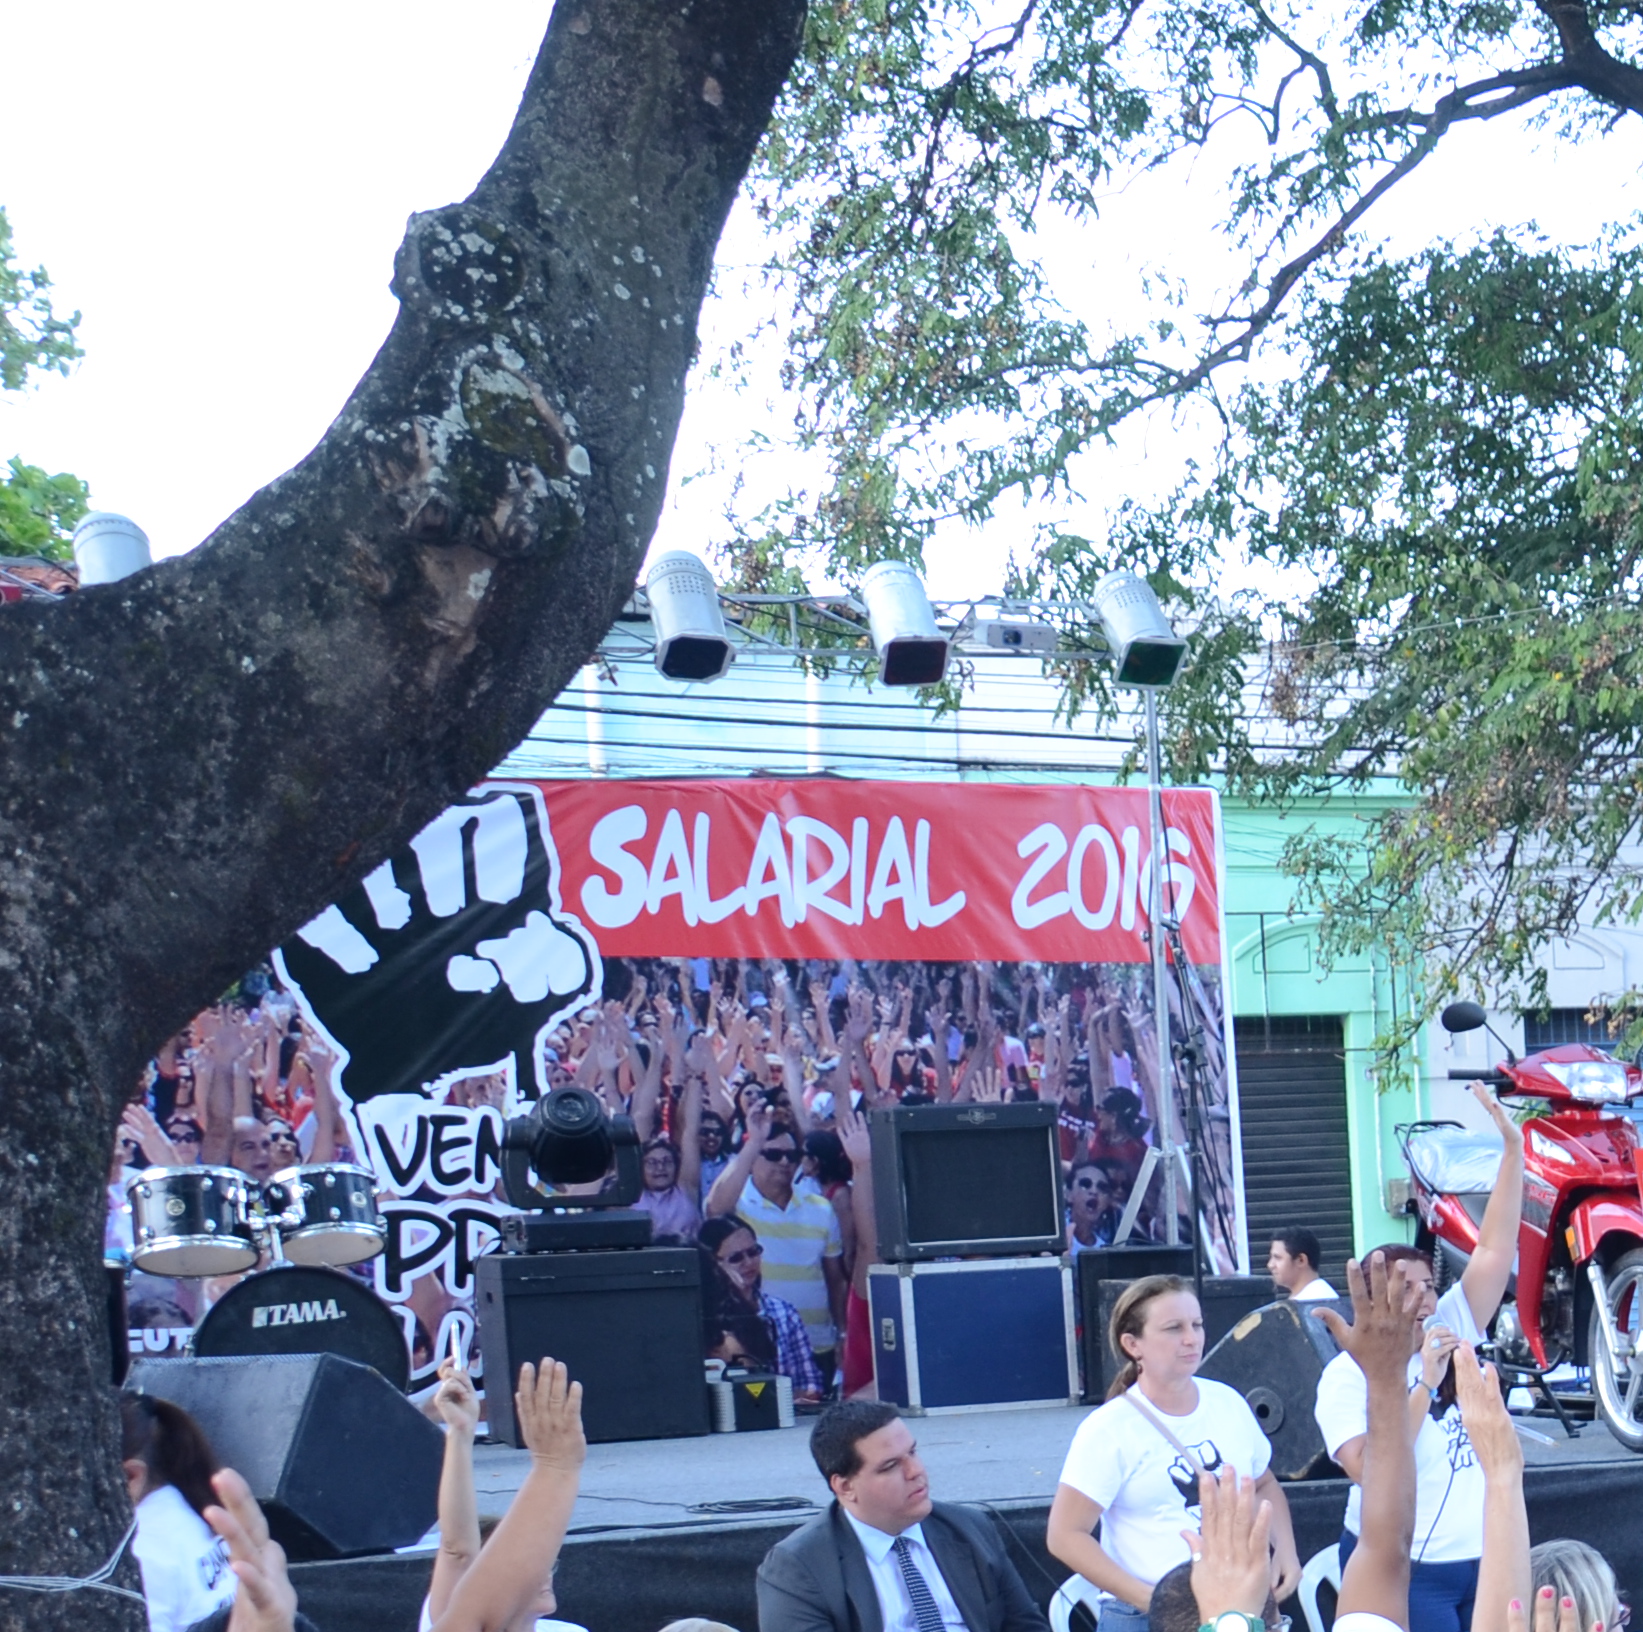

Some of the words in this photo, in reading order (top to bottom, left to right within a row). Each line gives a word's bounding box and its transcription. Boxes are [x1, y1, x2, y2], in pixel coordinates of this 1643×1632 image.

[580, 804, 967, 931] SALARIAL
[1011, 822, 1196, 932] 2016
[267, 1299, 340, 1326] TAMA
